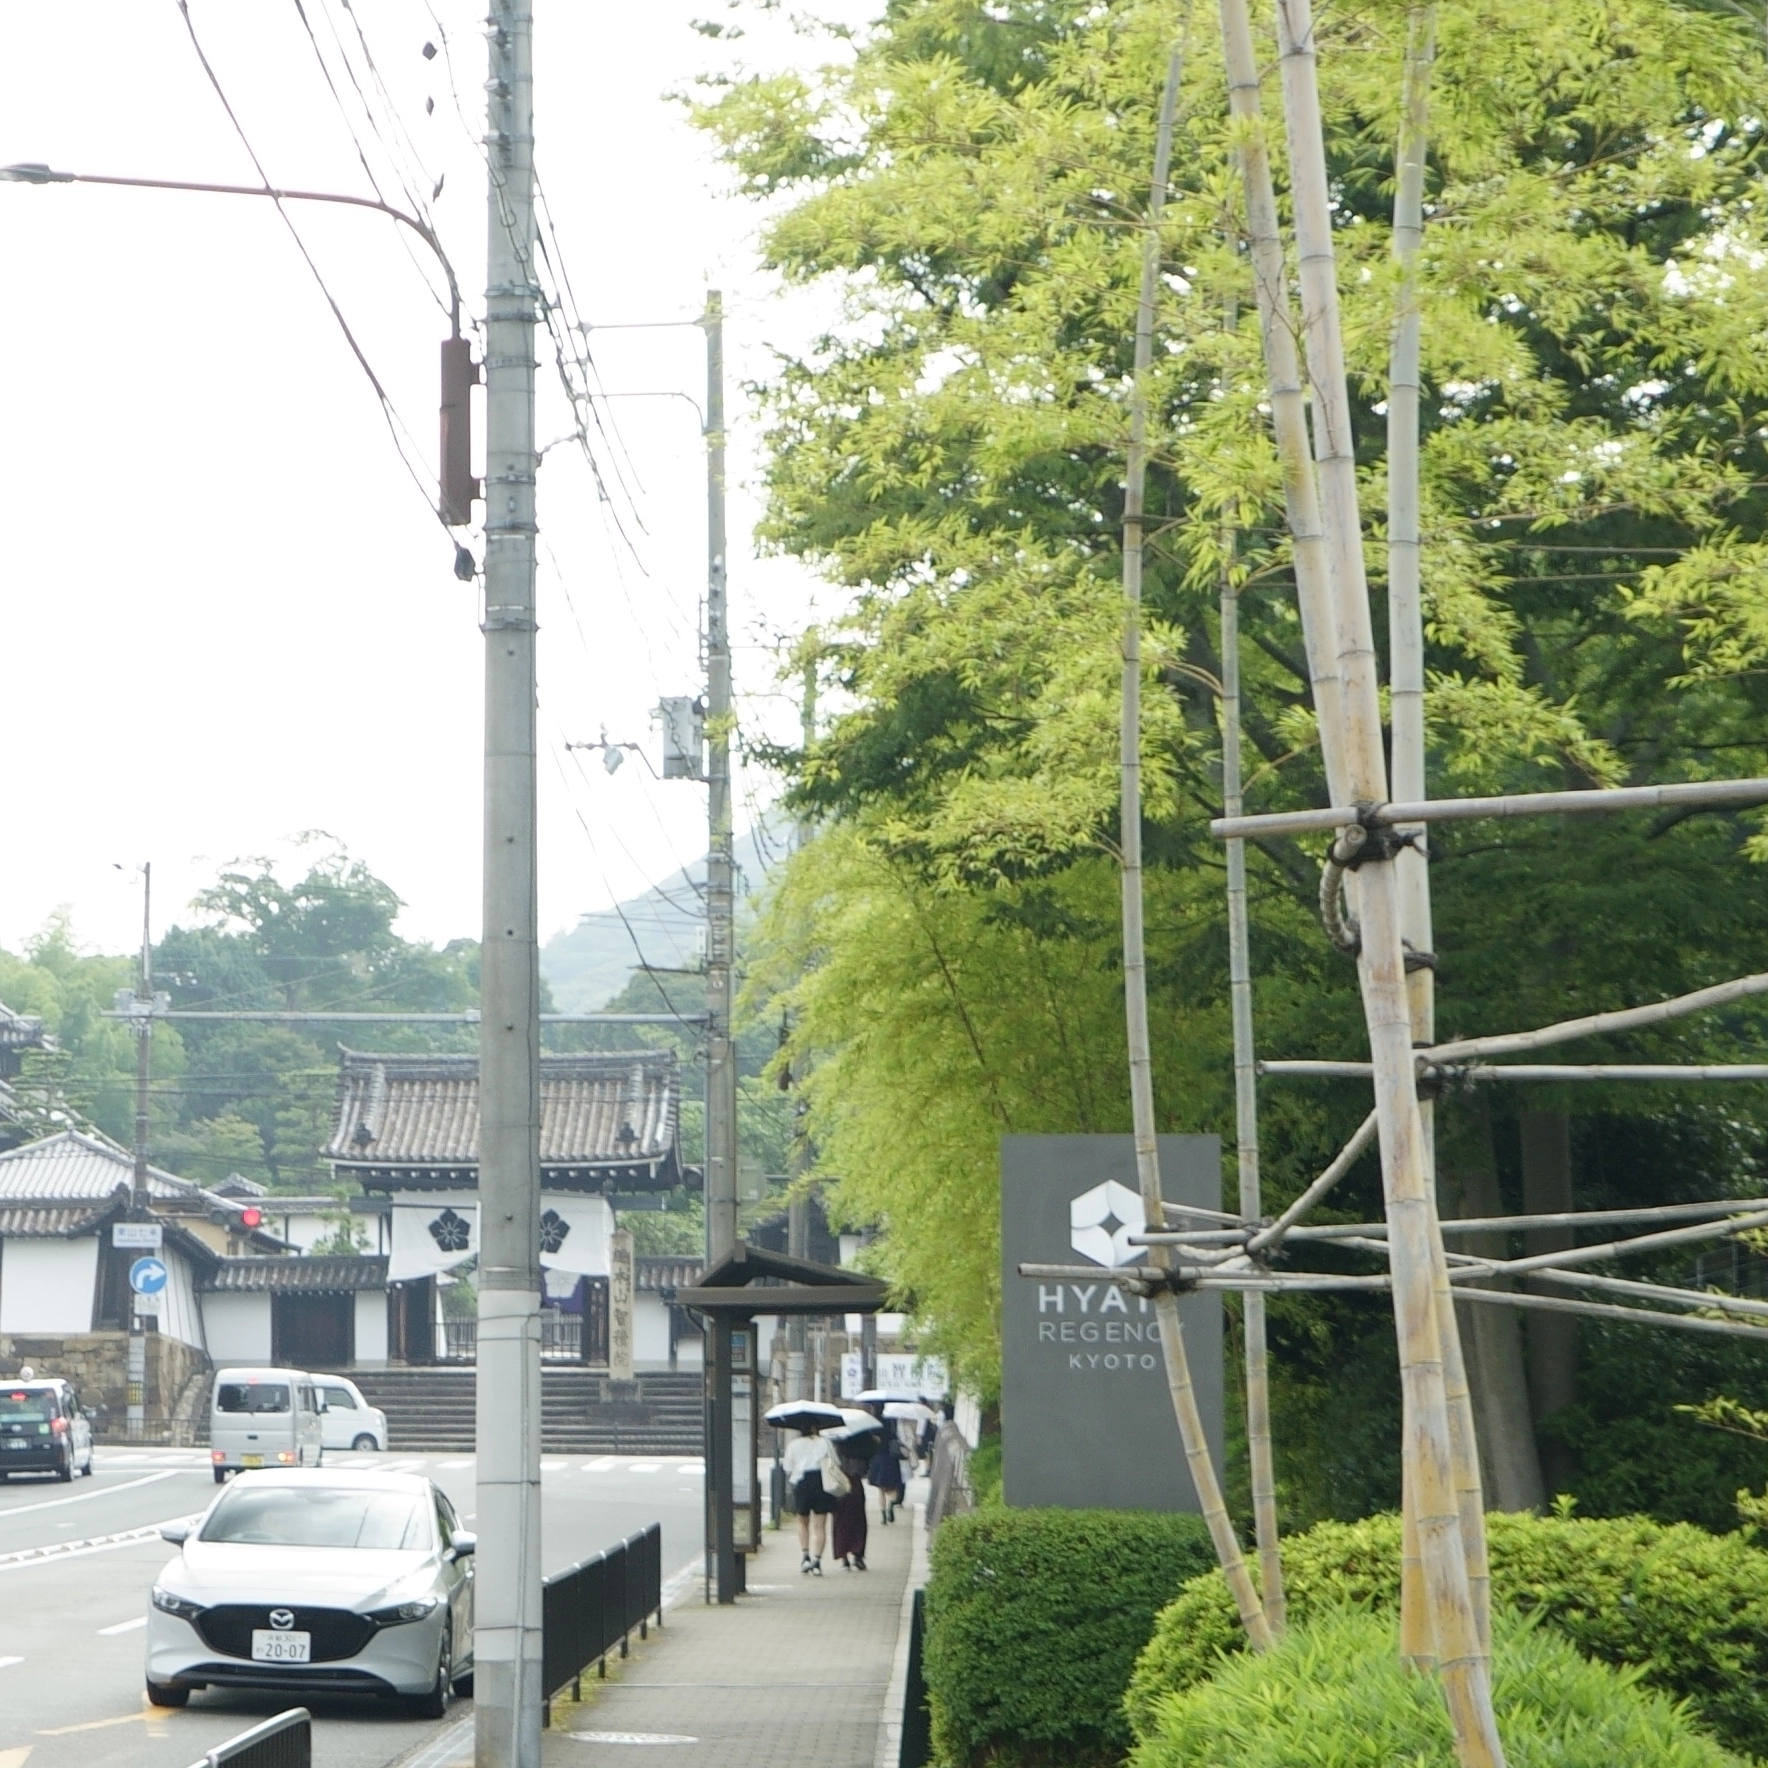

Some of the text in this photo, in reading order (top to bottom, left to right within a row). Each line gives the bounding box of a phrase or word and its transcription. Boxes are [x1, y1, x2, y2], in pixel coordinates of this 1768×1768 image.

[1039, 1284, 1148, 1313] HYA
[1039, 1321, 1184, 1343] REGENC
[1069, 1353, 1156, 1369] KYOTO
[265, 1643, 306, 1659] 20-07
